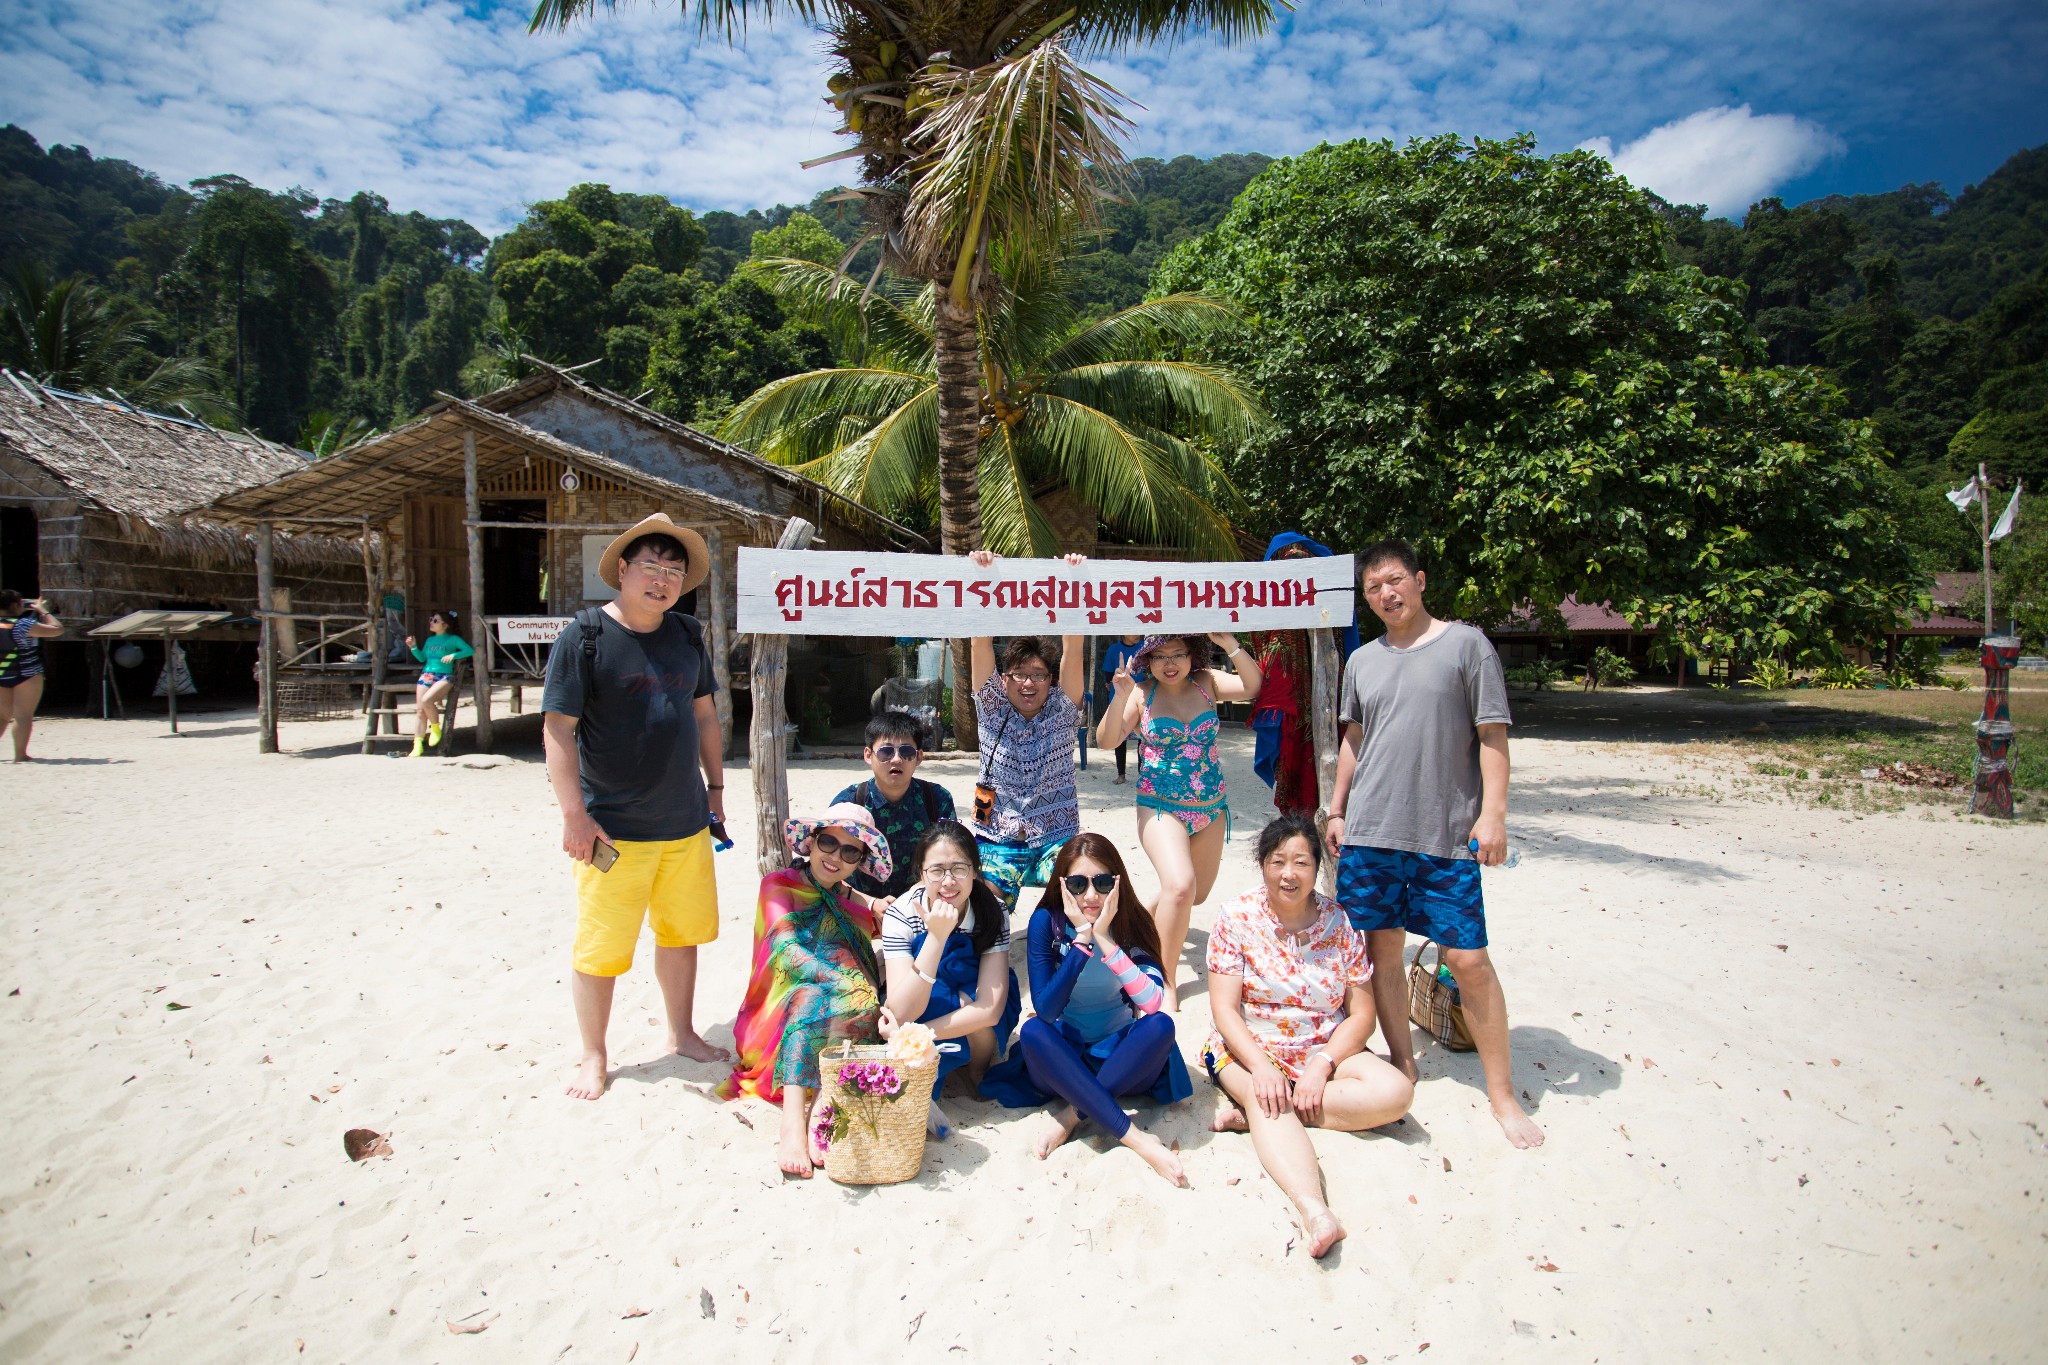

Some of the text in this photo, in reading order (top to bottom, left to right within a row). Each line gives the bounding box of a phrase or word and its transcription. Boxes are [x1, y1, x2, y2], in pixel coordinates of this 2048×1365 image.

[775, 567, 1316, 625] ศูนย์สาธารณสุขมูลฐานชุมชน
[507, 620, 560, 631] Community
[528, 632, 542, 641] Mu
[544, 632, 557, 641] ko
